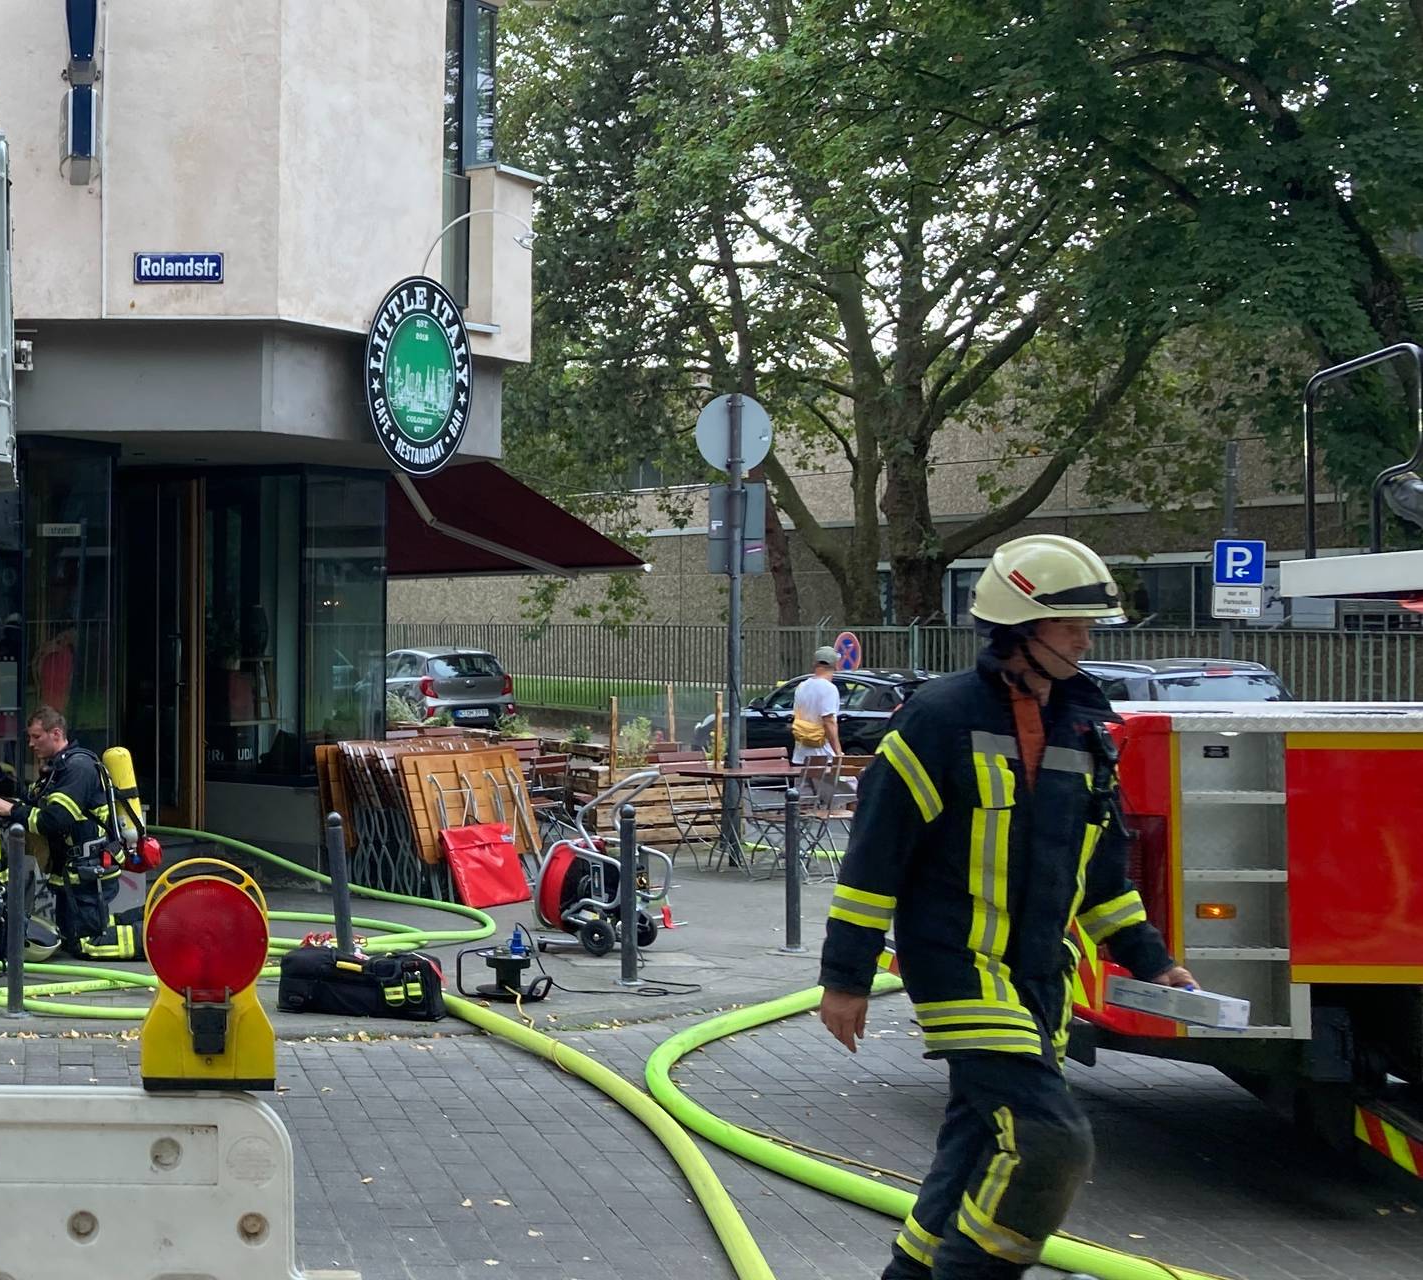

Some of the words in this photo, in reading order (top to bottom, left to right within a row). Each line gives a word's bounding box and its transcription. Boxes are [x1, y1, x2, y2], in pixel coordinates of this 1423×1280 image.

[140, 257, 220, 277] Rolandstr.
[369, 286, 428, 374] LITTLE
[430, 292, 469, 387] ITALY
[374, 397, 393, 435] CAFE
[394, 436, 446, 464] RESTAURANT
[448, 408, 464, 438] BAR
[1226, 546, 1253, 579] P
